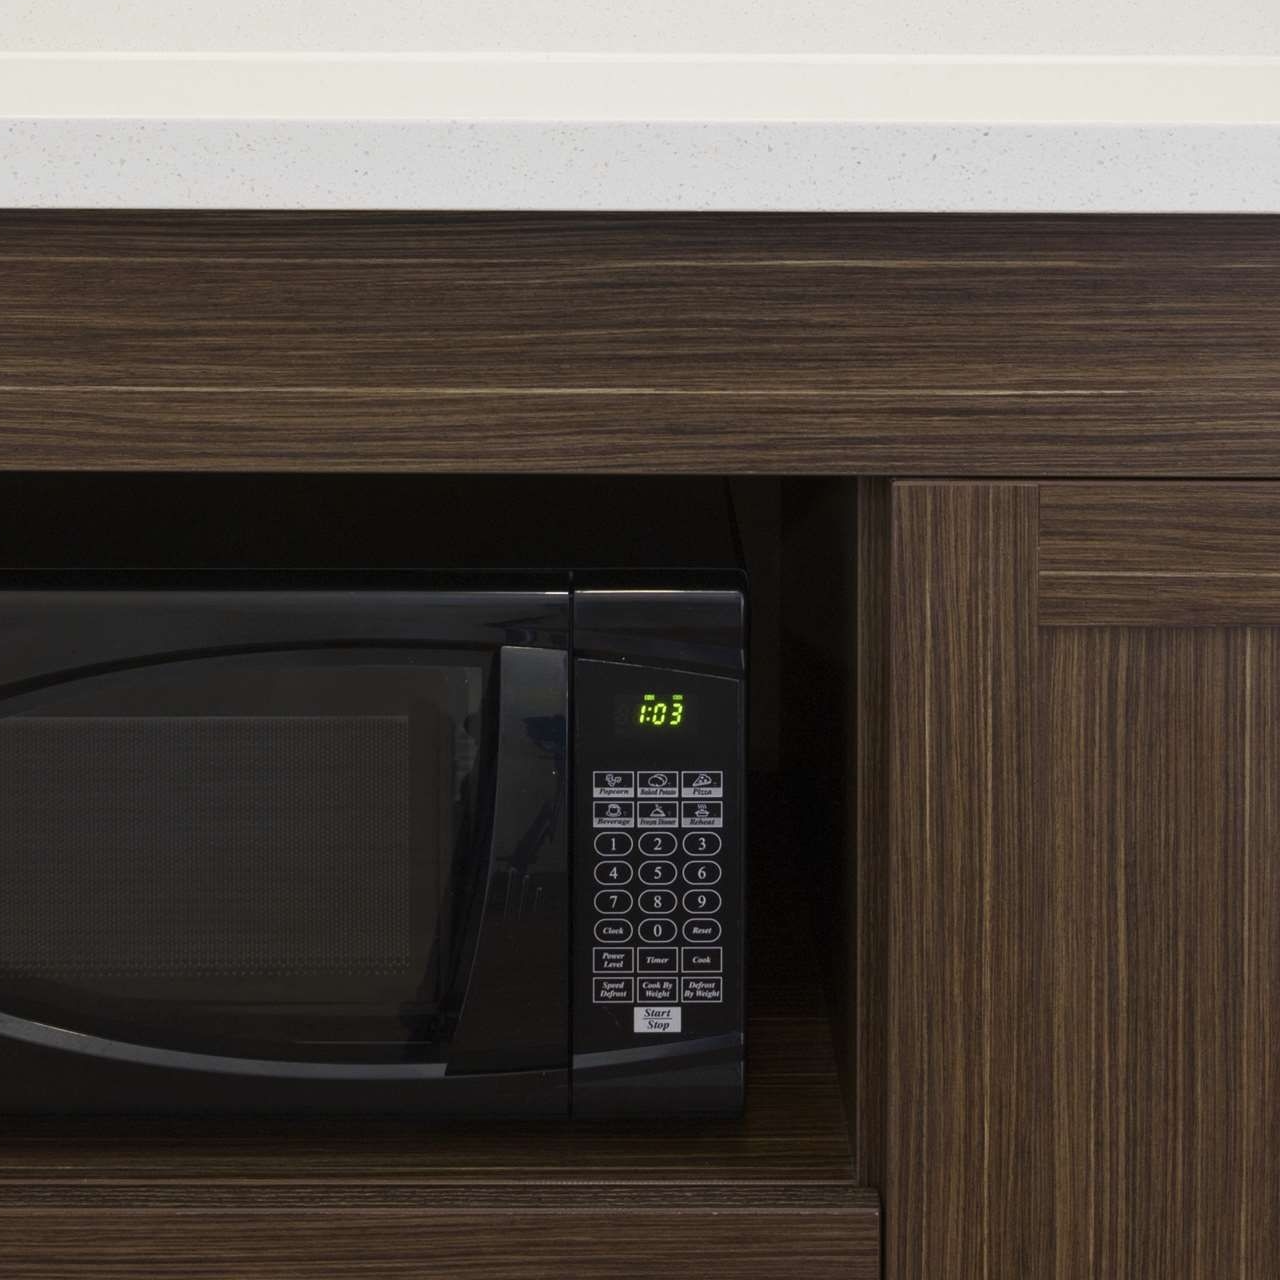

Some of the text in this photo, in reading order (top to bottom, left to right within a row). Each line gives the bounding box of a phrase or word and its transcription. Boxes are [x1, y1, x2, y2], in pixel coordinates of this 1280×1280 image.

[639, 703, 684, 725] 1:03
[610, 838, 616, 850] 1
[653, 838, 662, 850] 2
[698, 838, 706, 850] 3
[609, 867, 618, 879] 4
[654, 867, 662, 879] 5
[698, 867, 706, 879] 6
[610, 895, 618, 908] 7
[654, 896, 662, 908] 8
[698, 896, 706, 908] 9
[603, 927, 624, 935] Clock
[653, 924, 662, 937] 0
[693, 927, 712, 935] Reset
[646, 956, 669, 964] Timer
[692, 956, 711, 964] Cook
[603, 982, 624, 990] Speed
[663, 982, 672, 990] By
[689, 982, 715, 990] Defrost
[600, 990, 627, 998] Defrost
[646, 990, 670, 998] Weight
[684, 990, 720, 998] By Weight
[644, 1009, 671, 1017] Start
[647, 1020, 670, 1031] Stop
